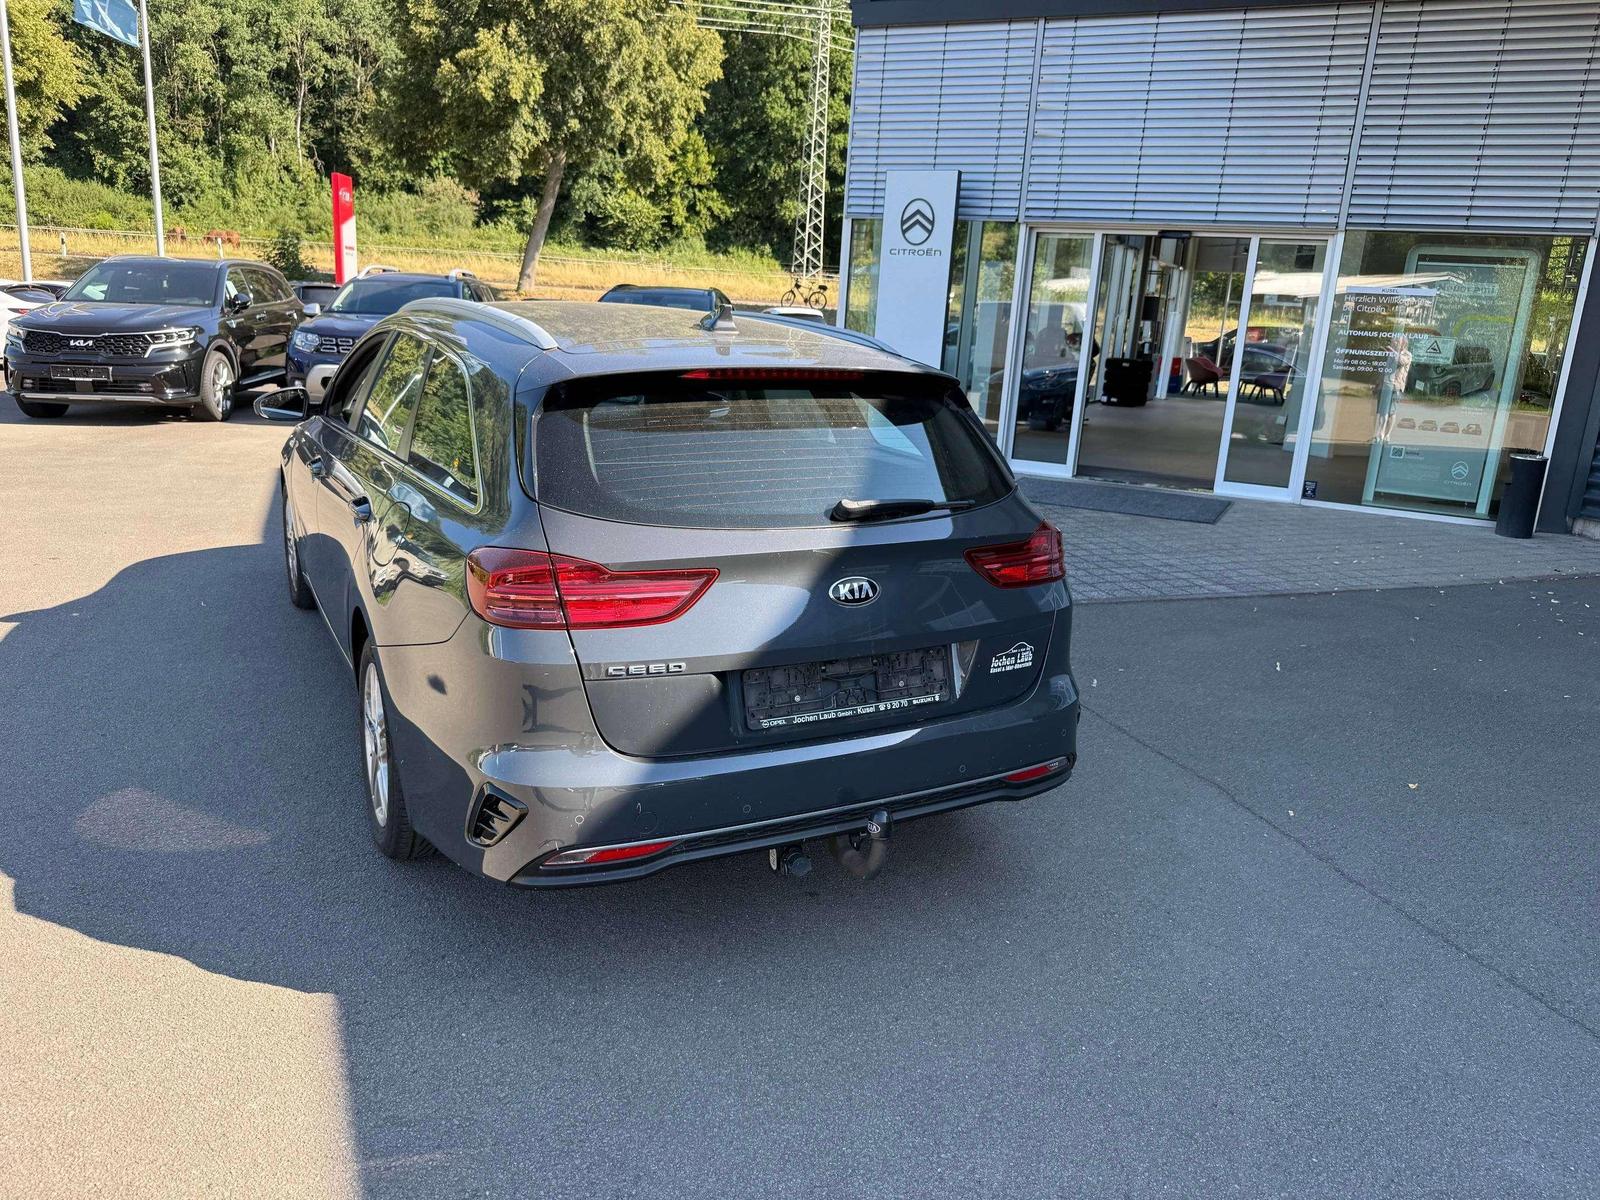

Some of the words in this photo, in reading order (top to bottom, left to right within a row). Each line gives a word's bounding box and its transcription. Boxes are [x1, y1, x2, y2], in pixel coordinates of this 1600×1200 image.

[889, 247, 942, 257] CITROËN
[1344, 294, 1376, 303] Herzlich
[1356, 304, 1385, 313] Citroën
[1335, 347, 1398, 357] ÖFFNUNGSZEITEN
[837, 581, 874, 600] KIA
[990, 655, 1015, 668] Jochen
[1017, 652, 1033, 664] Laub
[607, 662, 687, 676] CEED
[770, 719, 787, 727] OPEL
[792, 715, 818, 724] Jochen
[819, 711, 836, 720] Laub
[857, 705, 876, 714] Kusel
[892, 701, 900, 709] 20
[912, 696, 934, 704] SUZUKI
